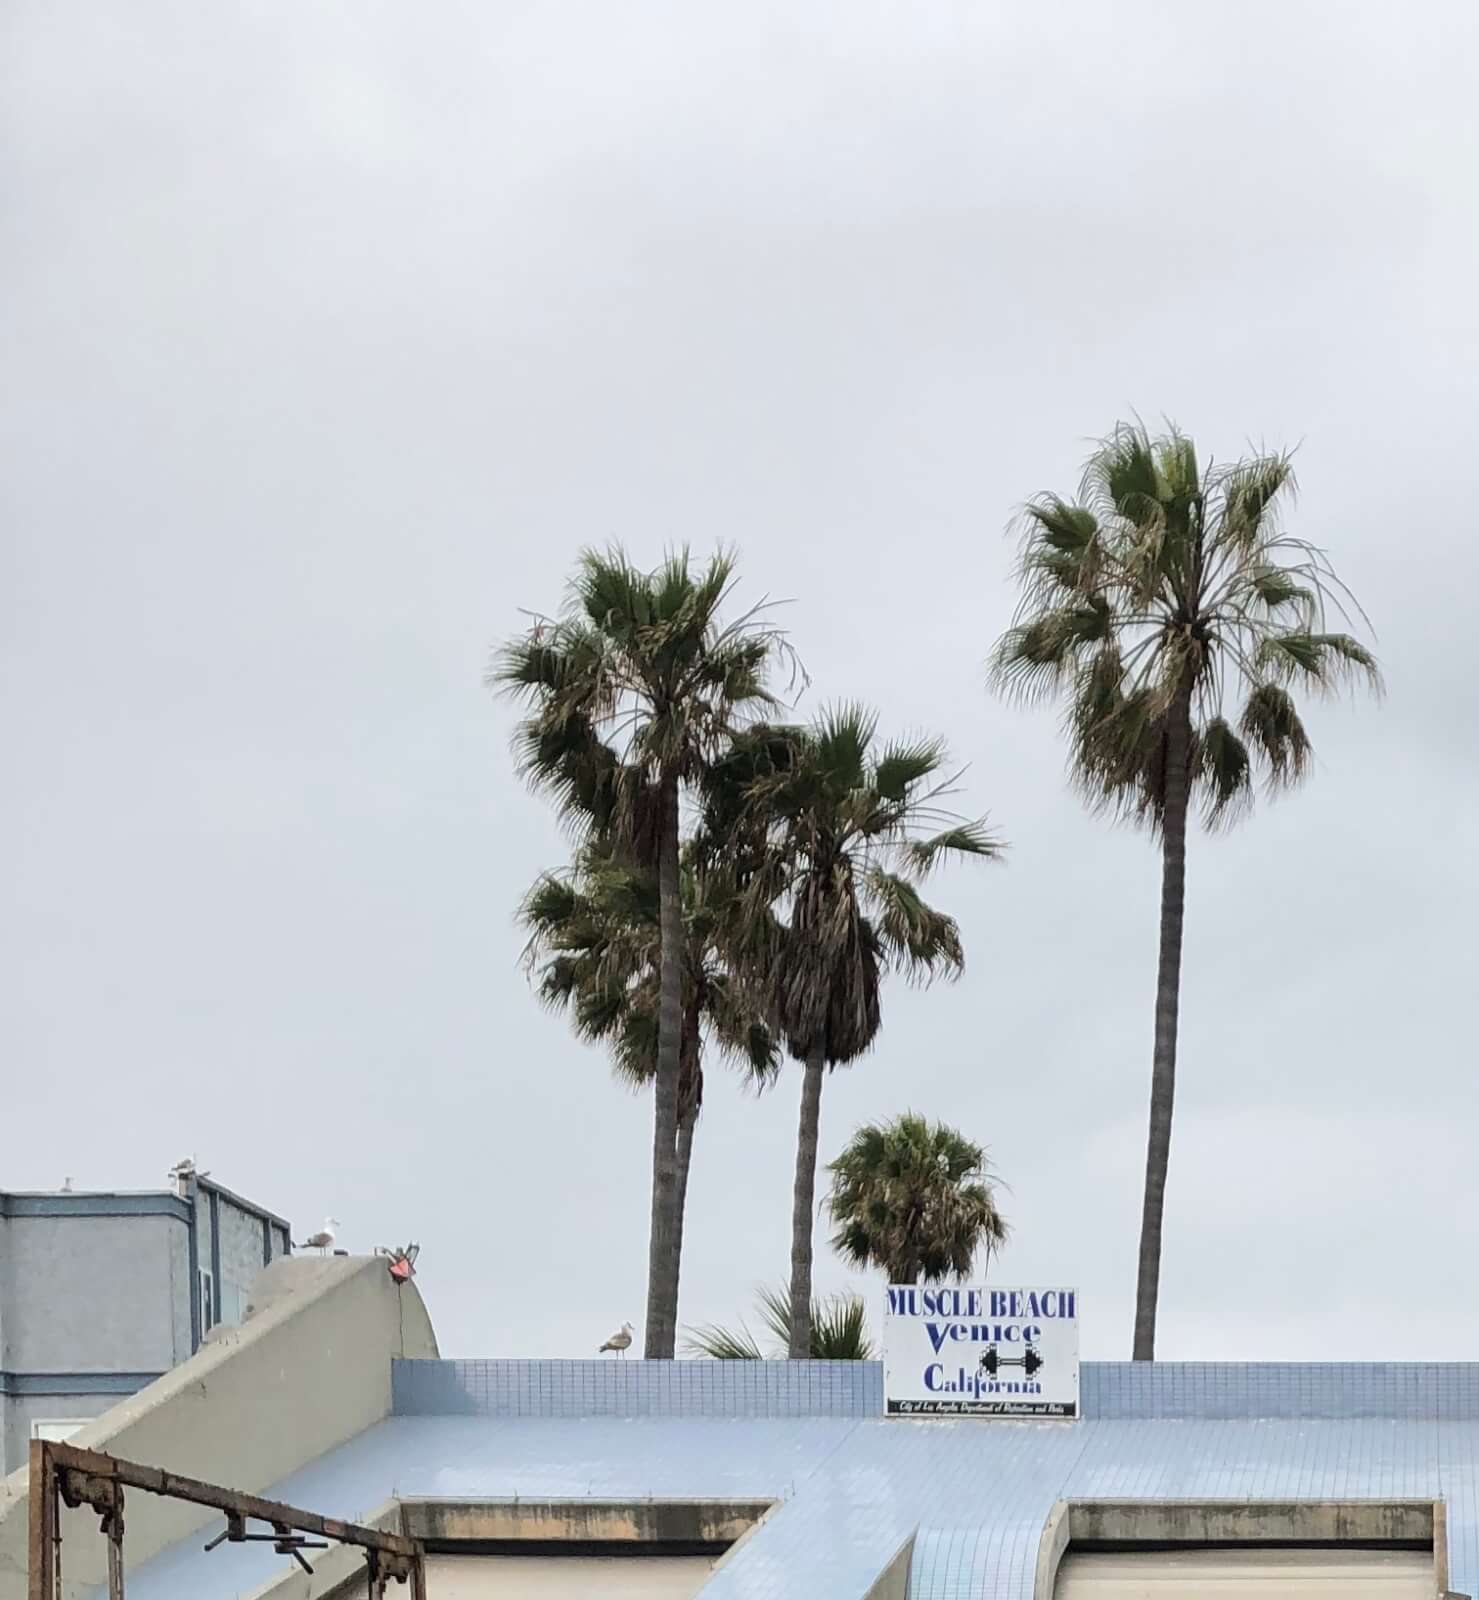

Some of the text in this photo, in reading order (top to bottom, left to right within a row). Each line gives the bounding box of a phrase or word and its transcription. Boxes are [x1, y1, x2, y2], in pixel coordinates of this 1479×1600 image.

[887, 1288, 1076, 1319] MUSCLE BEACH
[924, 1322, 1042, 1356] Venice
[923, 1363, 1042, 1400] California
